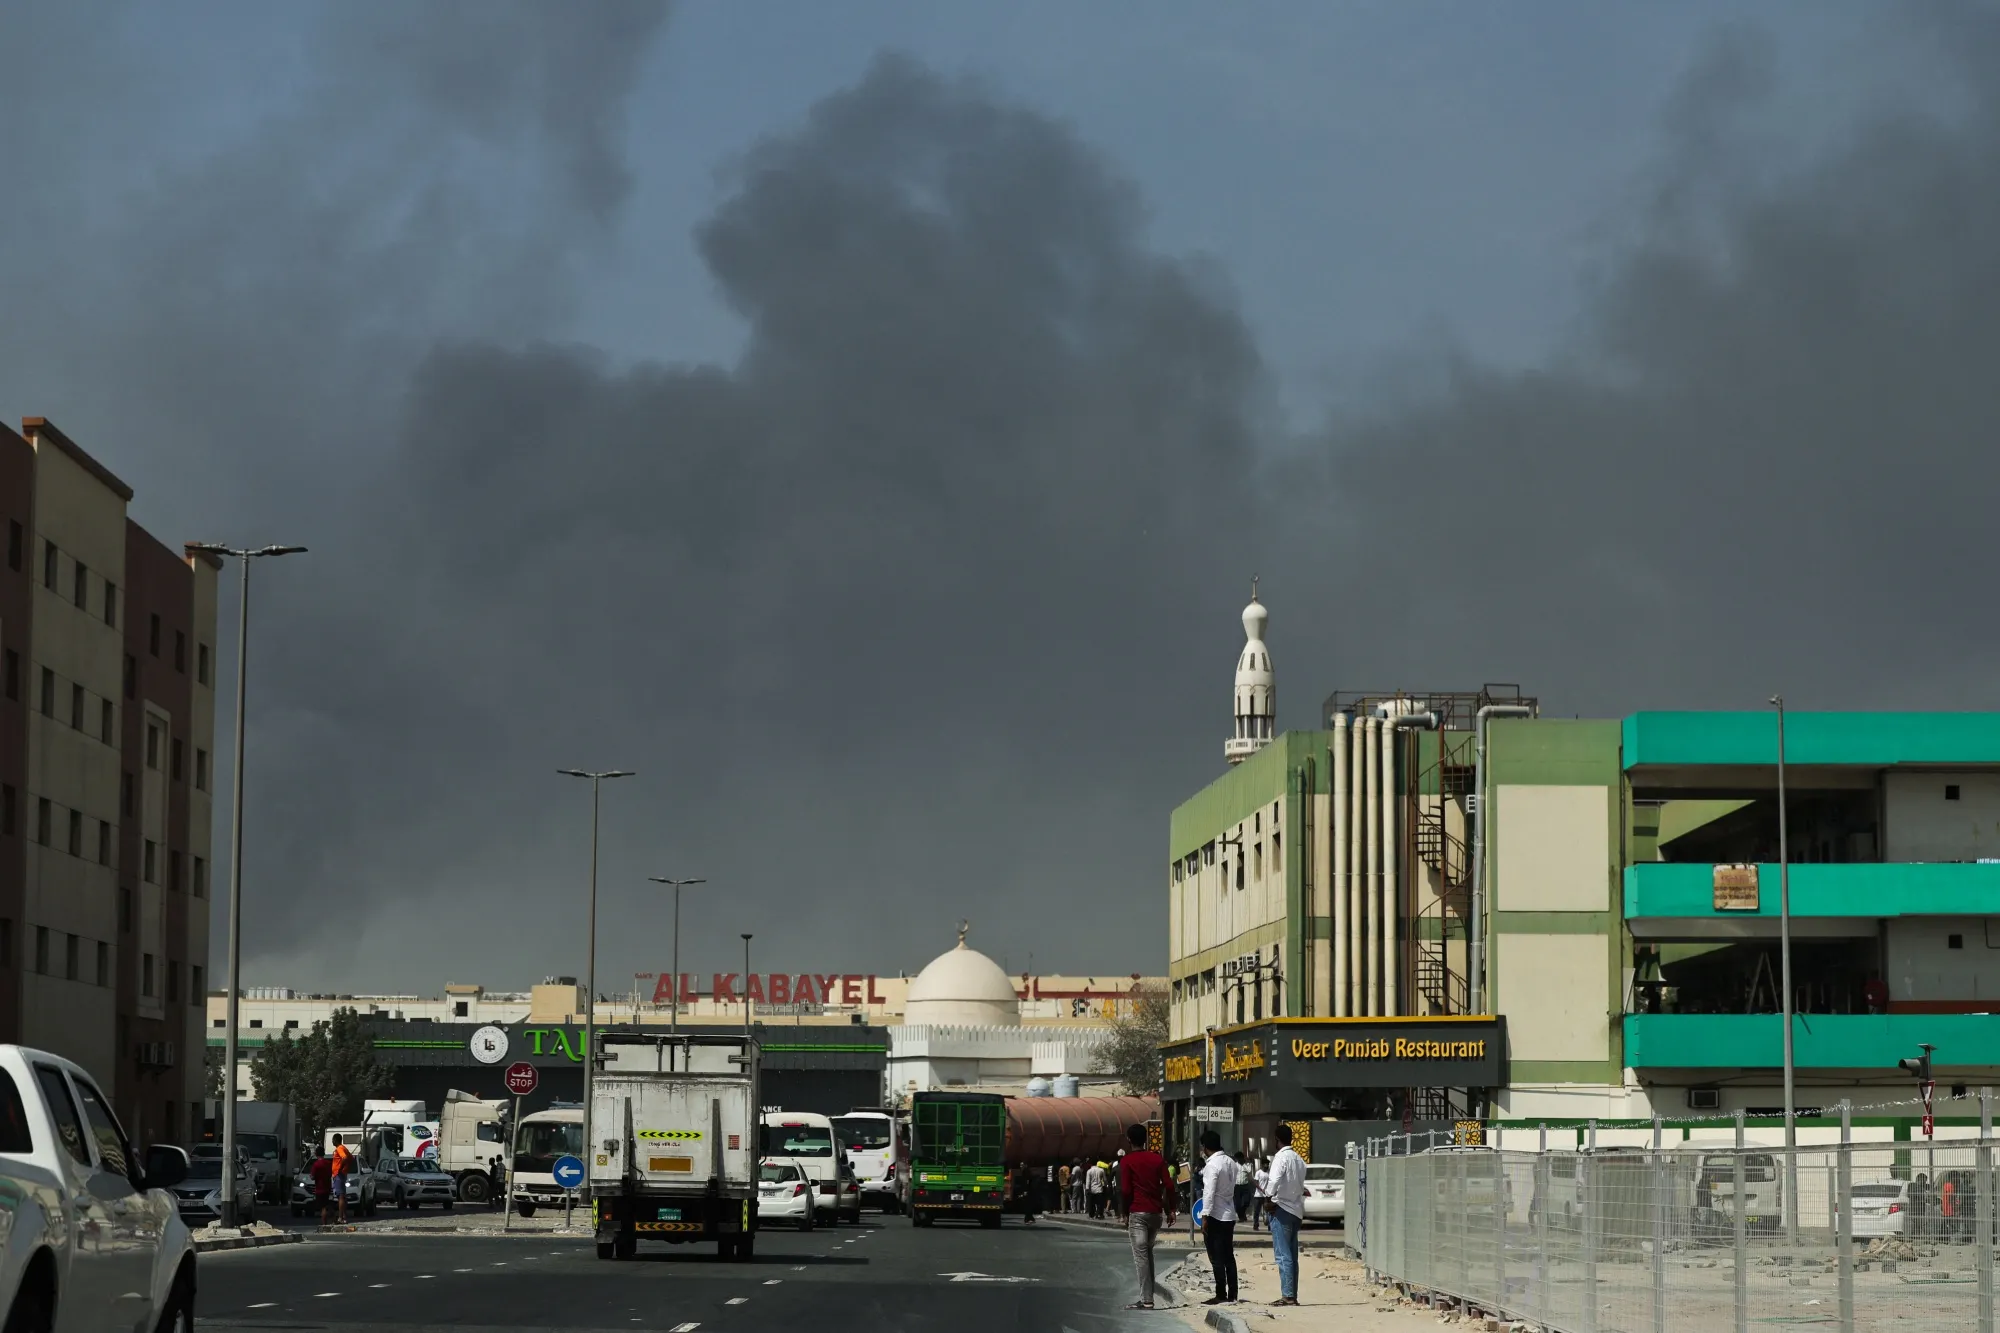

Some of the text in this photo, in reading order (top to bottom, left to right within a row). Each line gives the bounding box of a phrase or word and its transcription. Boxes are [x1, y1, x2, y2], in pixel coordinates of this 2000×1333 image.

[652, 973, 886, 1004] AL KABAYEL
[1292, 1038, 1485, 1058] Veer Punjab Restaurant
[511, 1067, 533, 1078] قف
[510, 1079, 533, 1087] STOP
[760, 1105, 782, 1113] ANCE
[1210, 1110, 1219, 1118] 26
